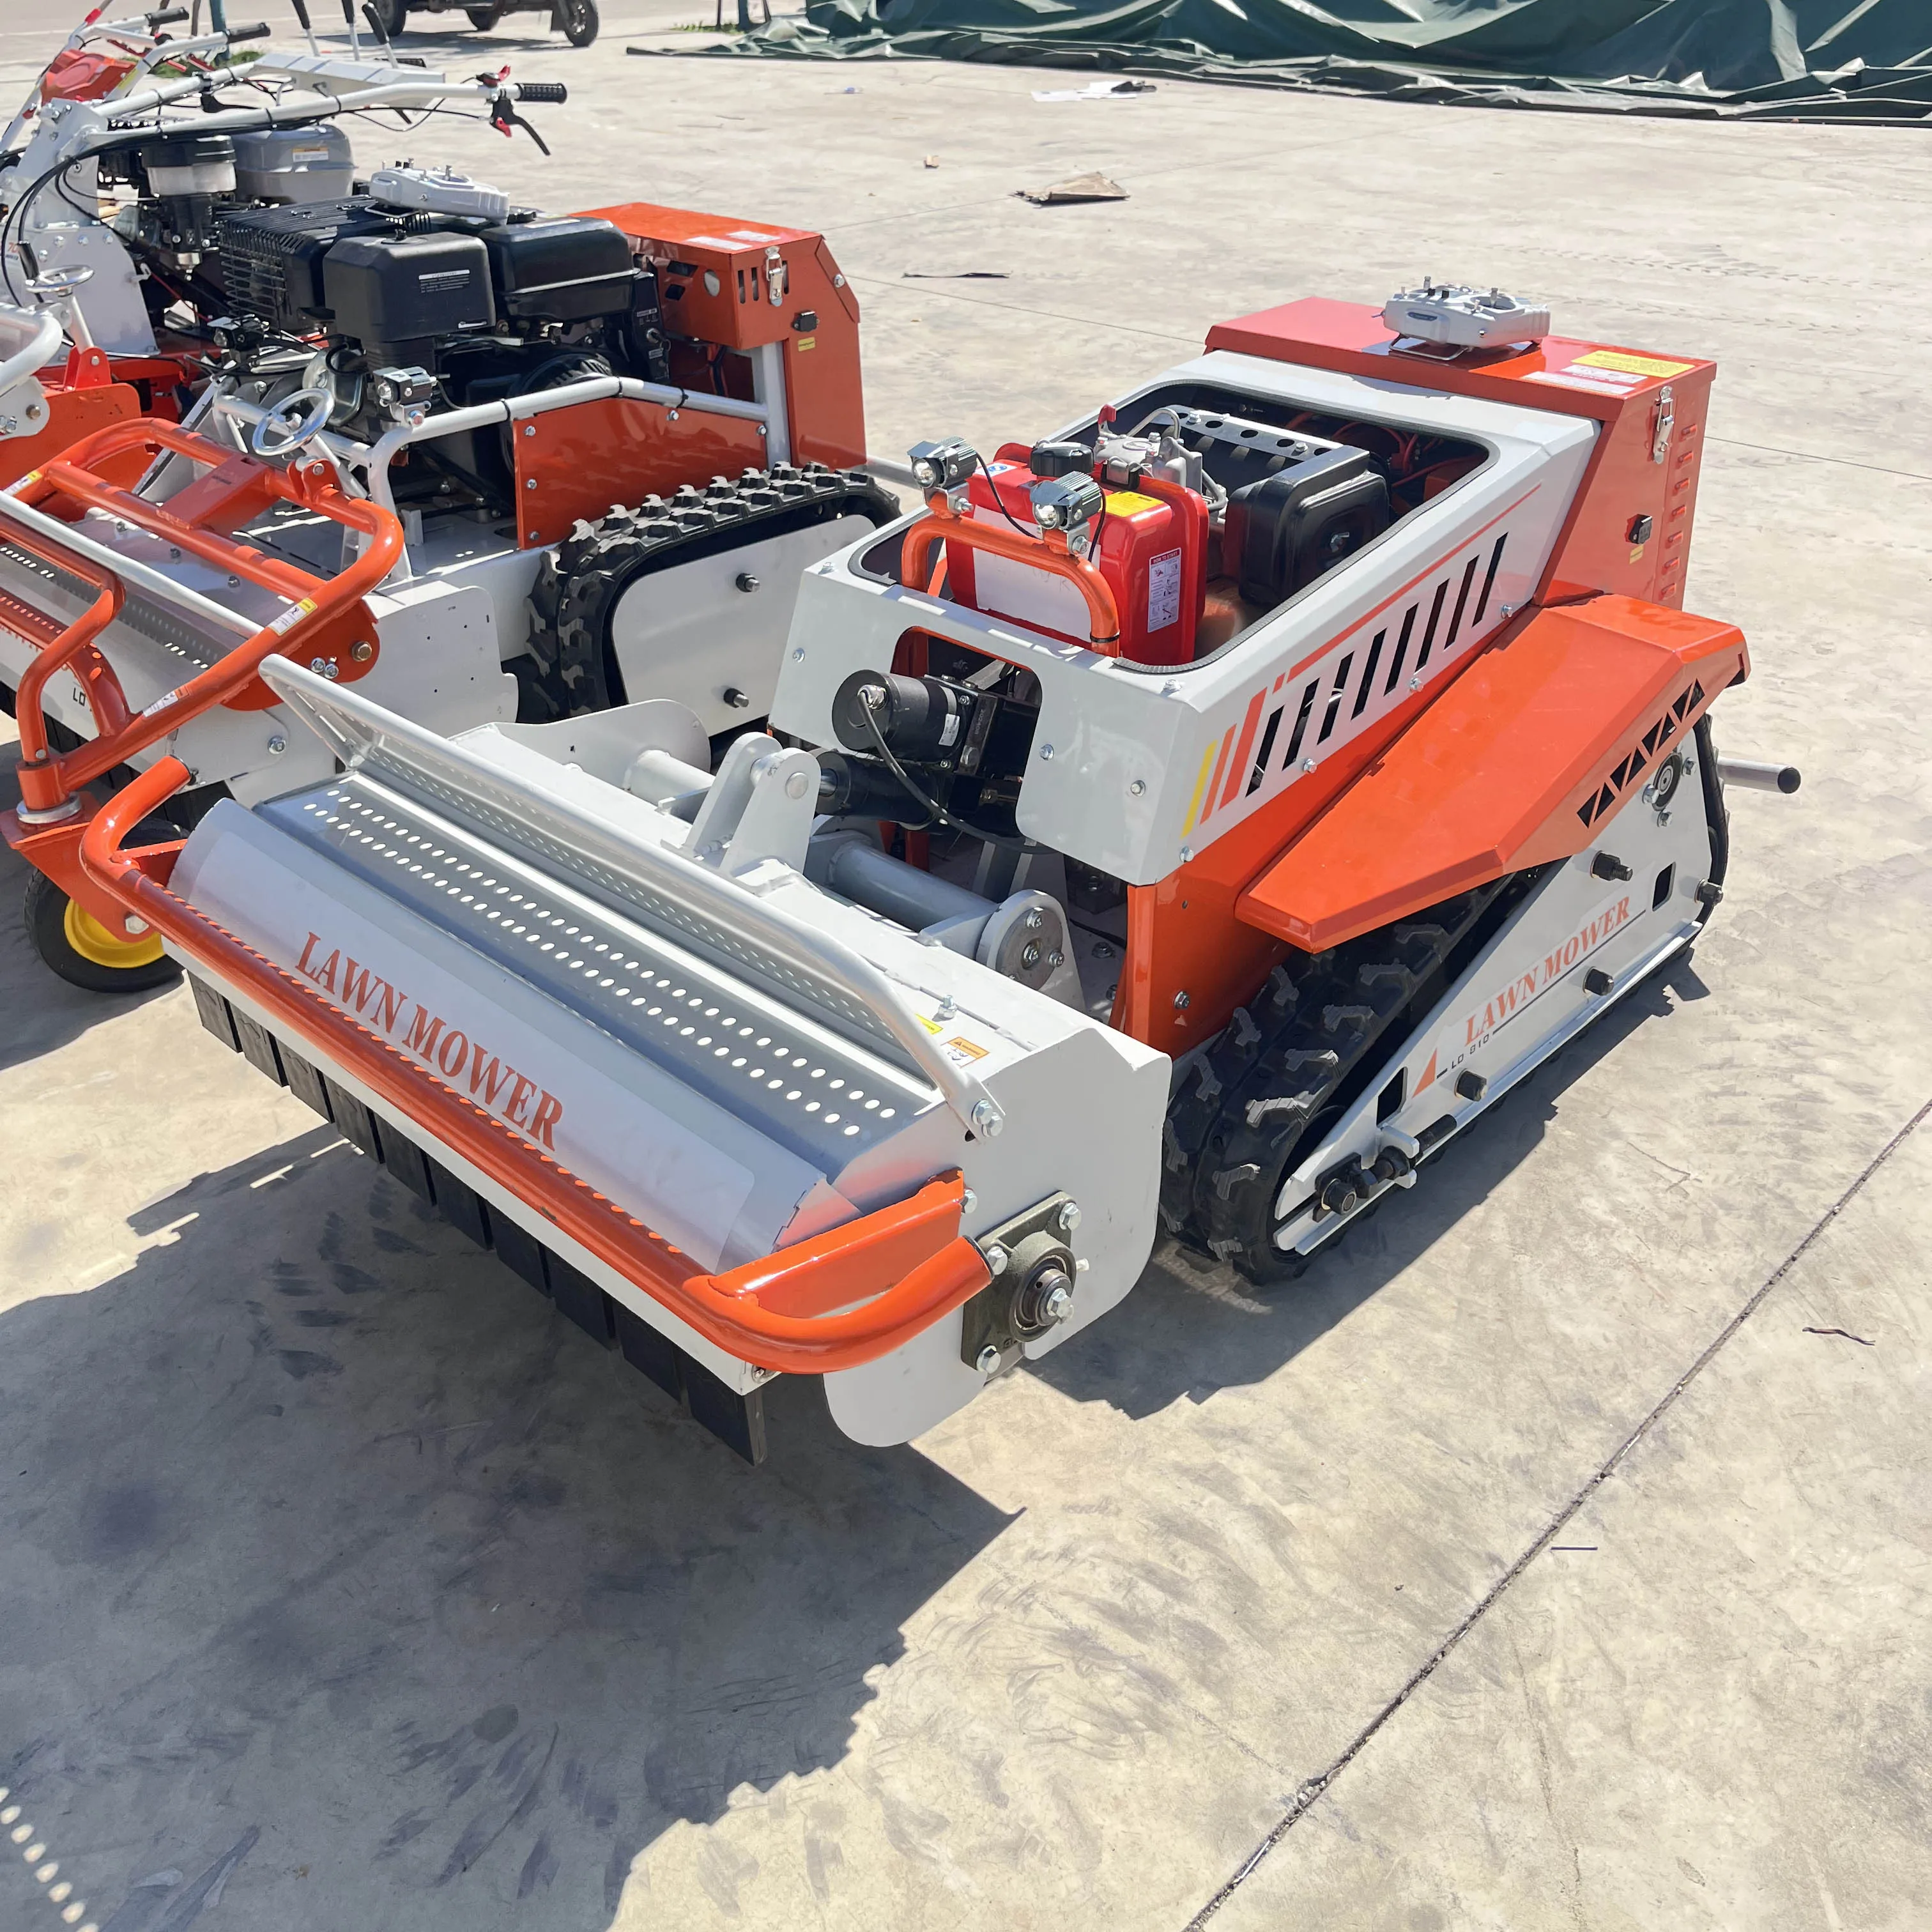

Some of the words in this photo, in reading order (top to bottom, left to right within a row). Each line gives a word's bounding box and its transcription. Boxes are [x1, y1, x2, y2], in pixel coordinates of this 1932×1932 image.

[295, 931, 408, 1034] LAWN
[401, 1004, 563, 1151] MOWER
[1464, 965, 1538, 1047] LAWN
[1542, 896, 1630, 985] MOWER
